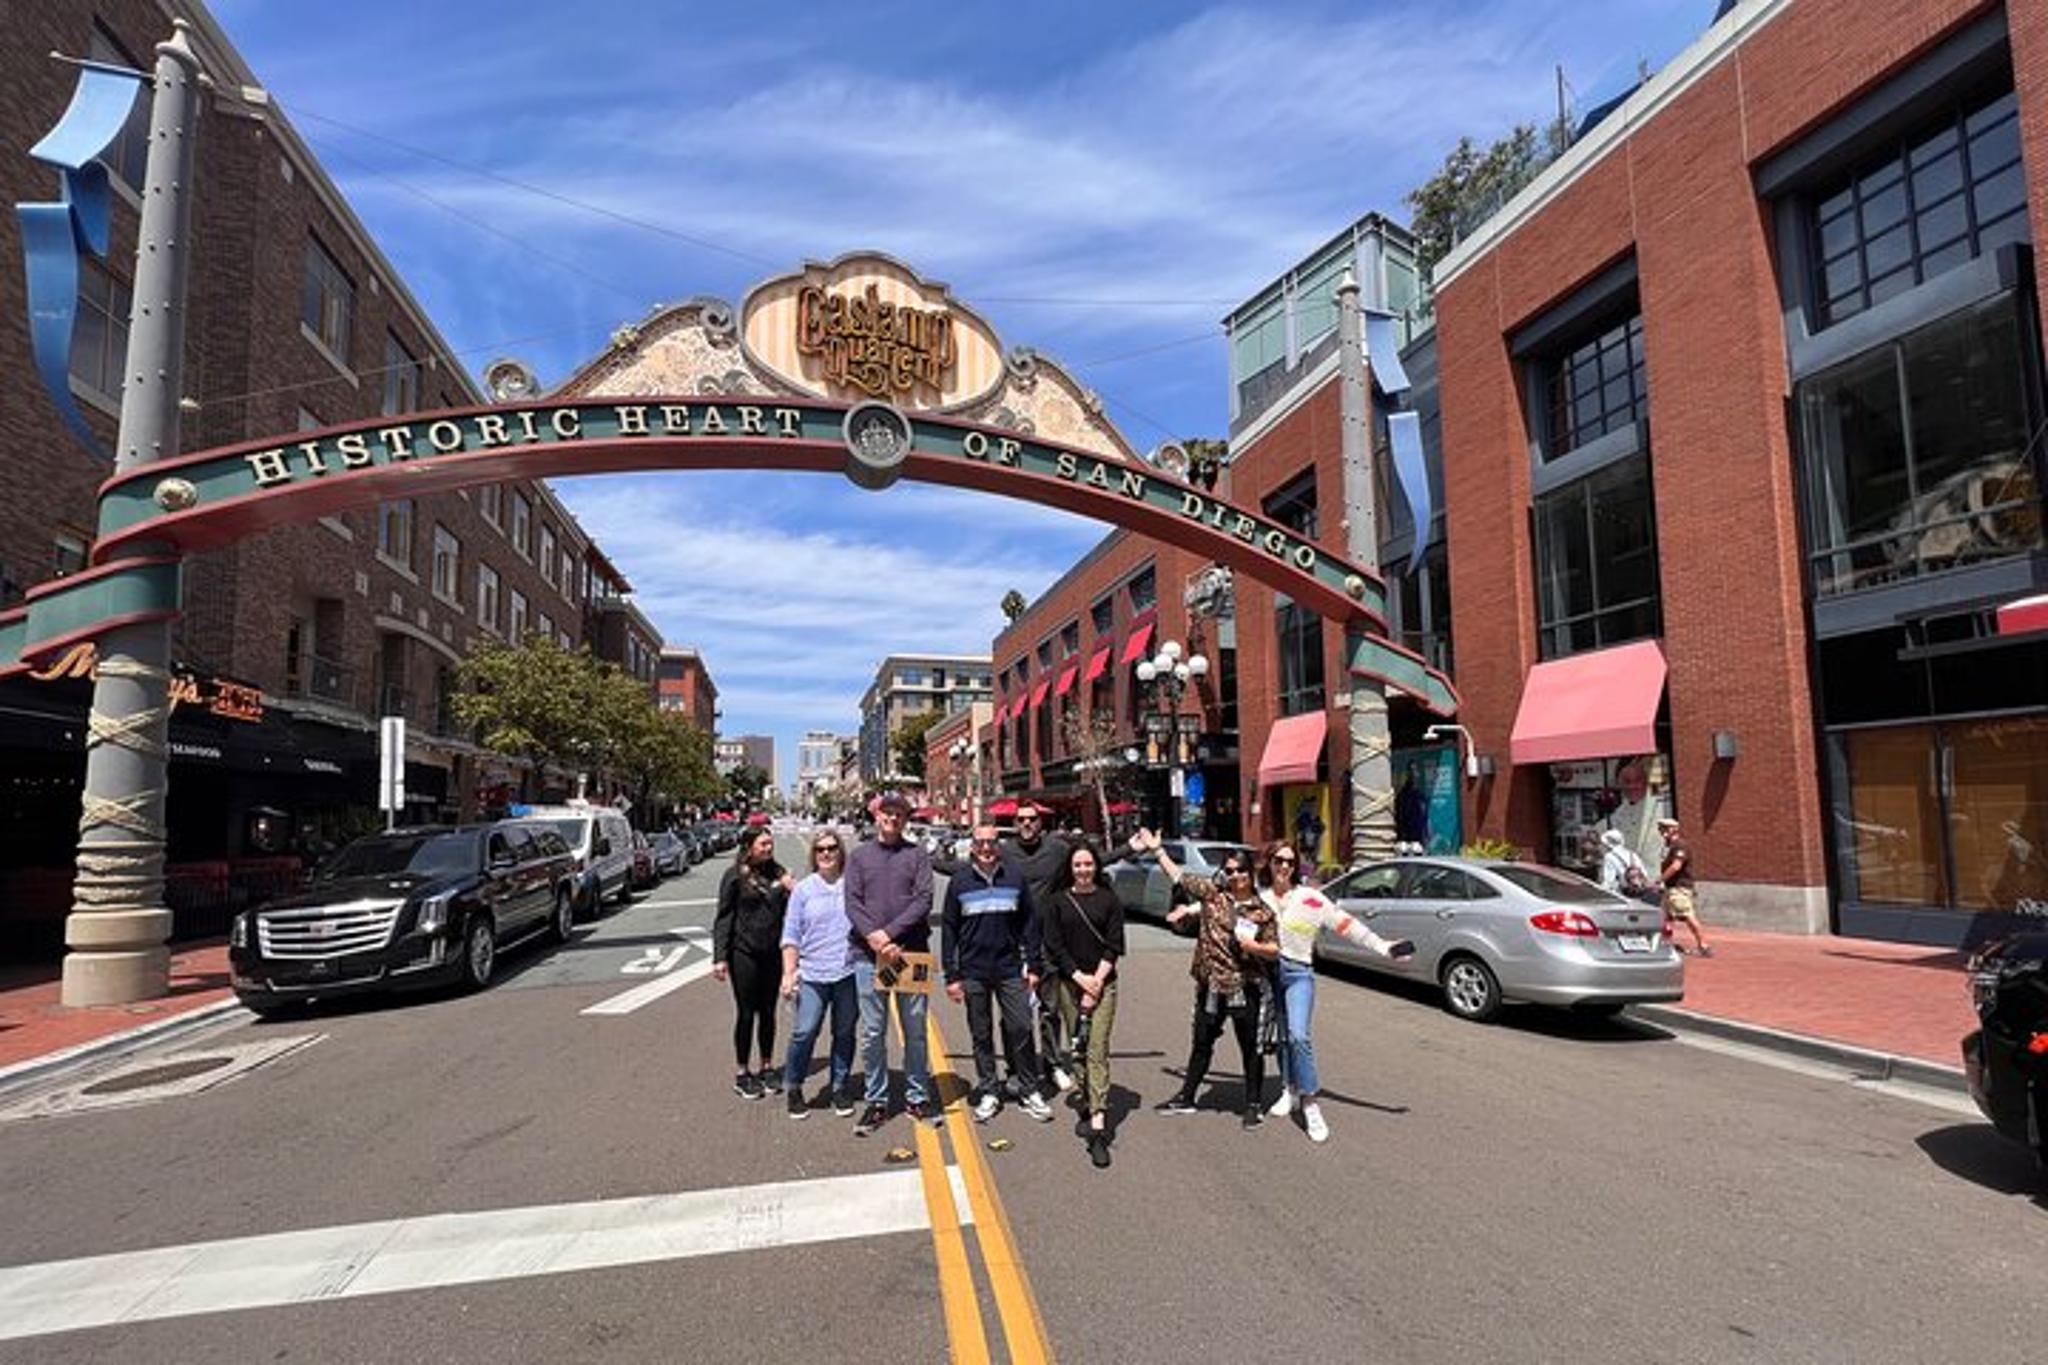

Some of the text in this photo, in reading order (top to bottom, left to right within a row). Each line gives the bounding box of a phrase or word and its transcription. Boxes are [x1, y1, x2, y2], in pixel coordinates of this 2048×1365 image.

[797, 284, 959, 374] Gaslamp
[244, 405, 801, 486] HISTORIC HEART
[963, 431, 1316, 568] OF SAN DIEGO
